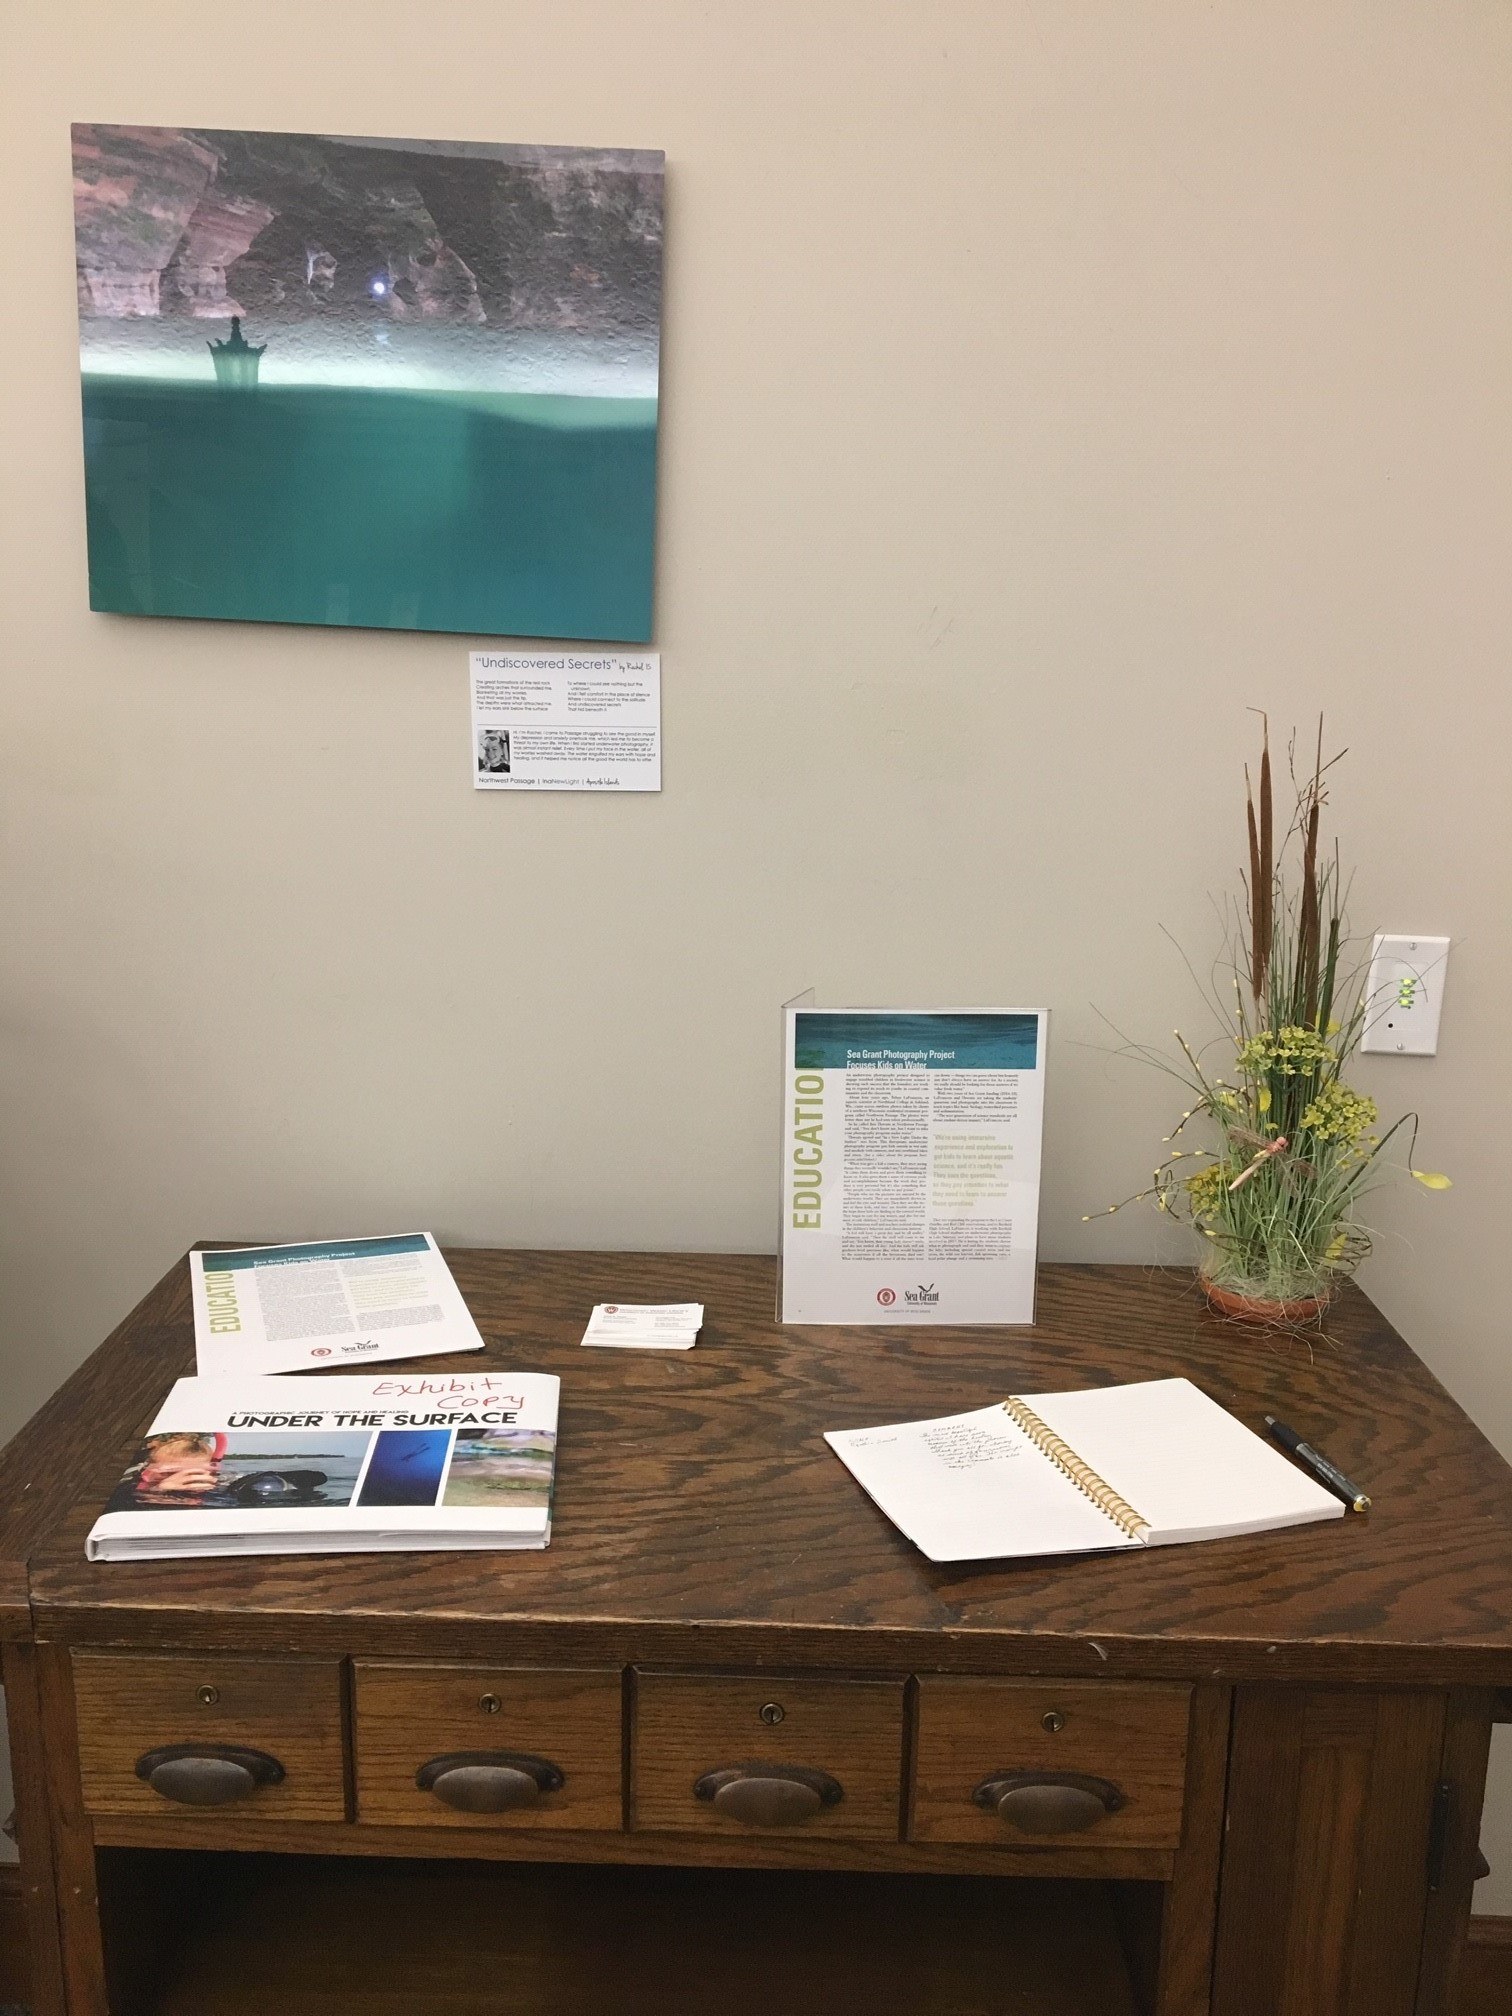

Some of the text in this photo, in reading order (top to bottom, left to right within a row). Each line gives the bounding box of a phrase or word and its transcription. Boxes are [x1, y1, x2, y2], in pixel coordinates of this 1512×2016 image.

[568, 658, 617, 670] Secrets"
[847, 1050, 955, 1061] Sea Grant Photography Project
[878, 1060, 894, 1070] Kids
[904, 1060, 928, 1070] Water
[904, 1290, 918, 1301] Sea
[919, 1290, 939, 1301] Grant
[372, 1378, 502, 1396] Exhibit
[228, 1412, 518, 1427] UNDER THE SURFACE
